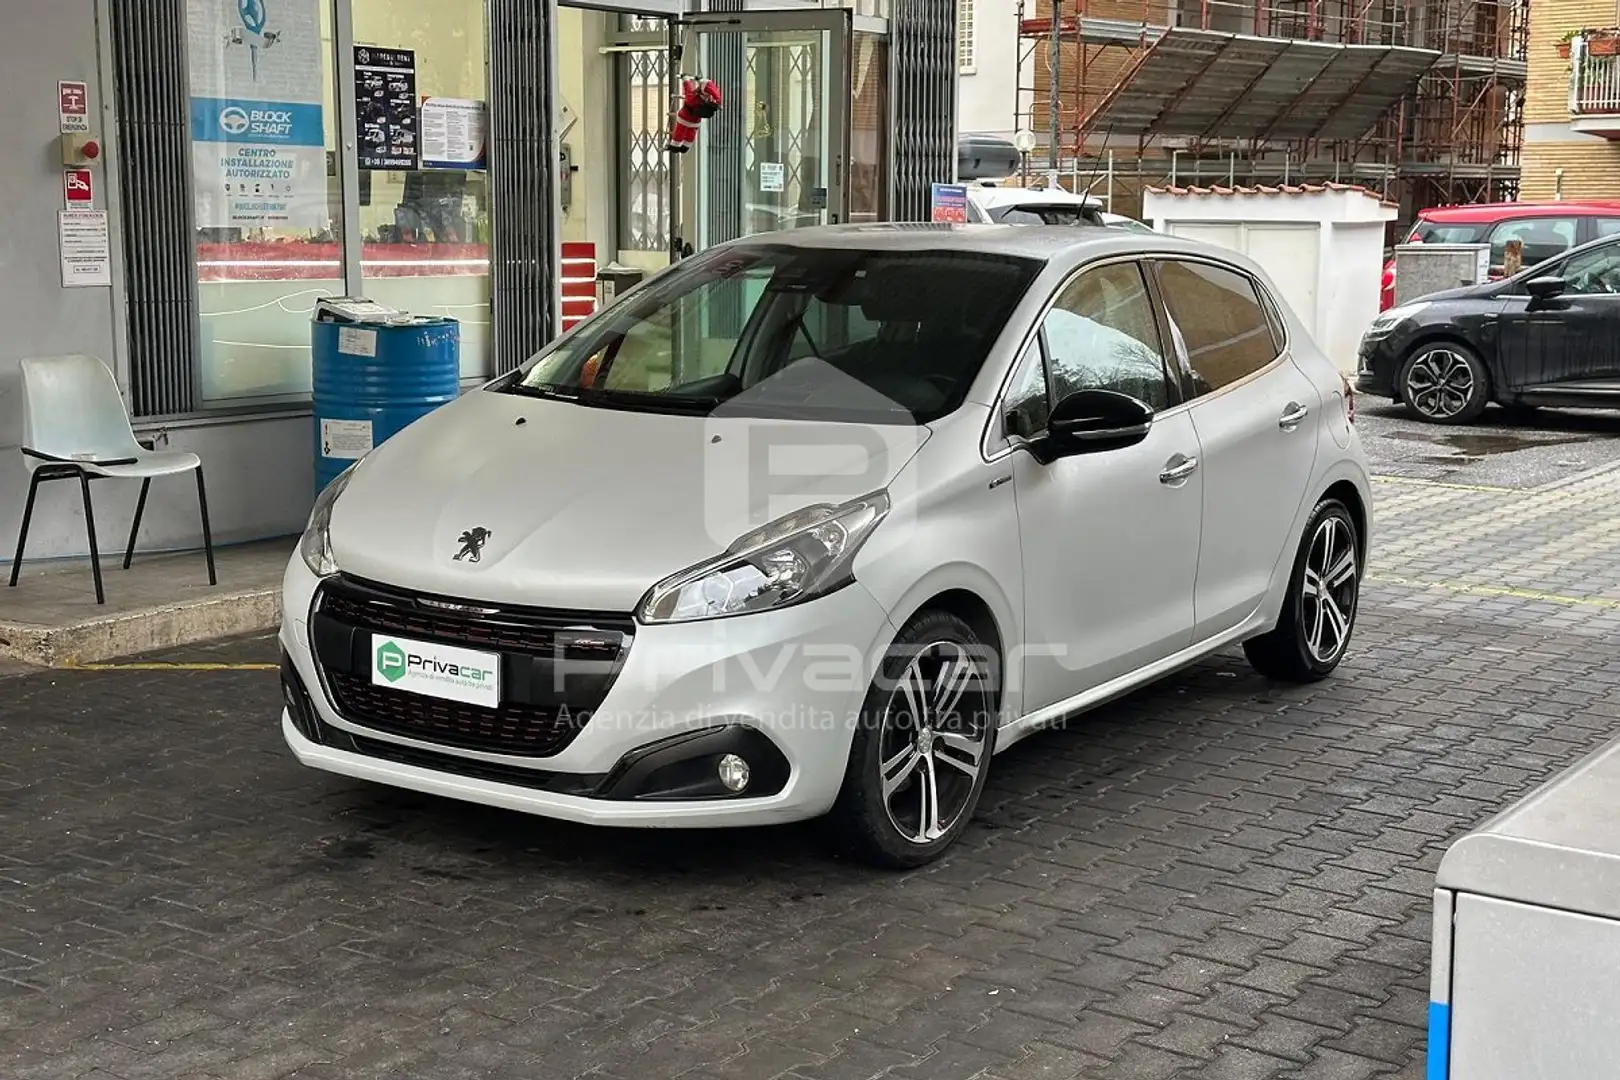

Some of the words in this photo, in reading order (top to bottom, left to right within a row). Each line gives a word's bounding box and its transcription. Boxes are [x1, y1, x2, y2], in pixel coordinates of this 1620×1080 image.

[250, 111, 292, 122] BLOCK
[251, 123, 292, 134] SHAFT
[238, 148, 277, 157] CENTRO
[221, 158, 294, 168] INSTALLAZIONE
[226, 167, 290, 178] AUTORIZZATO
[407, 653, 493, 681] Privacar
